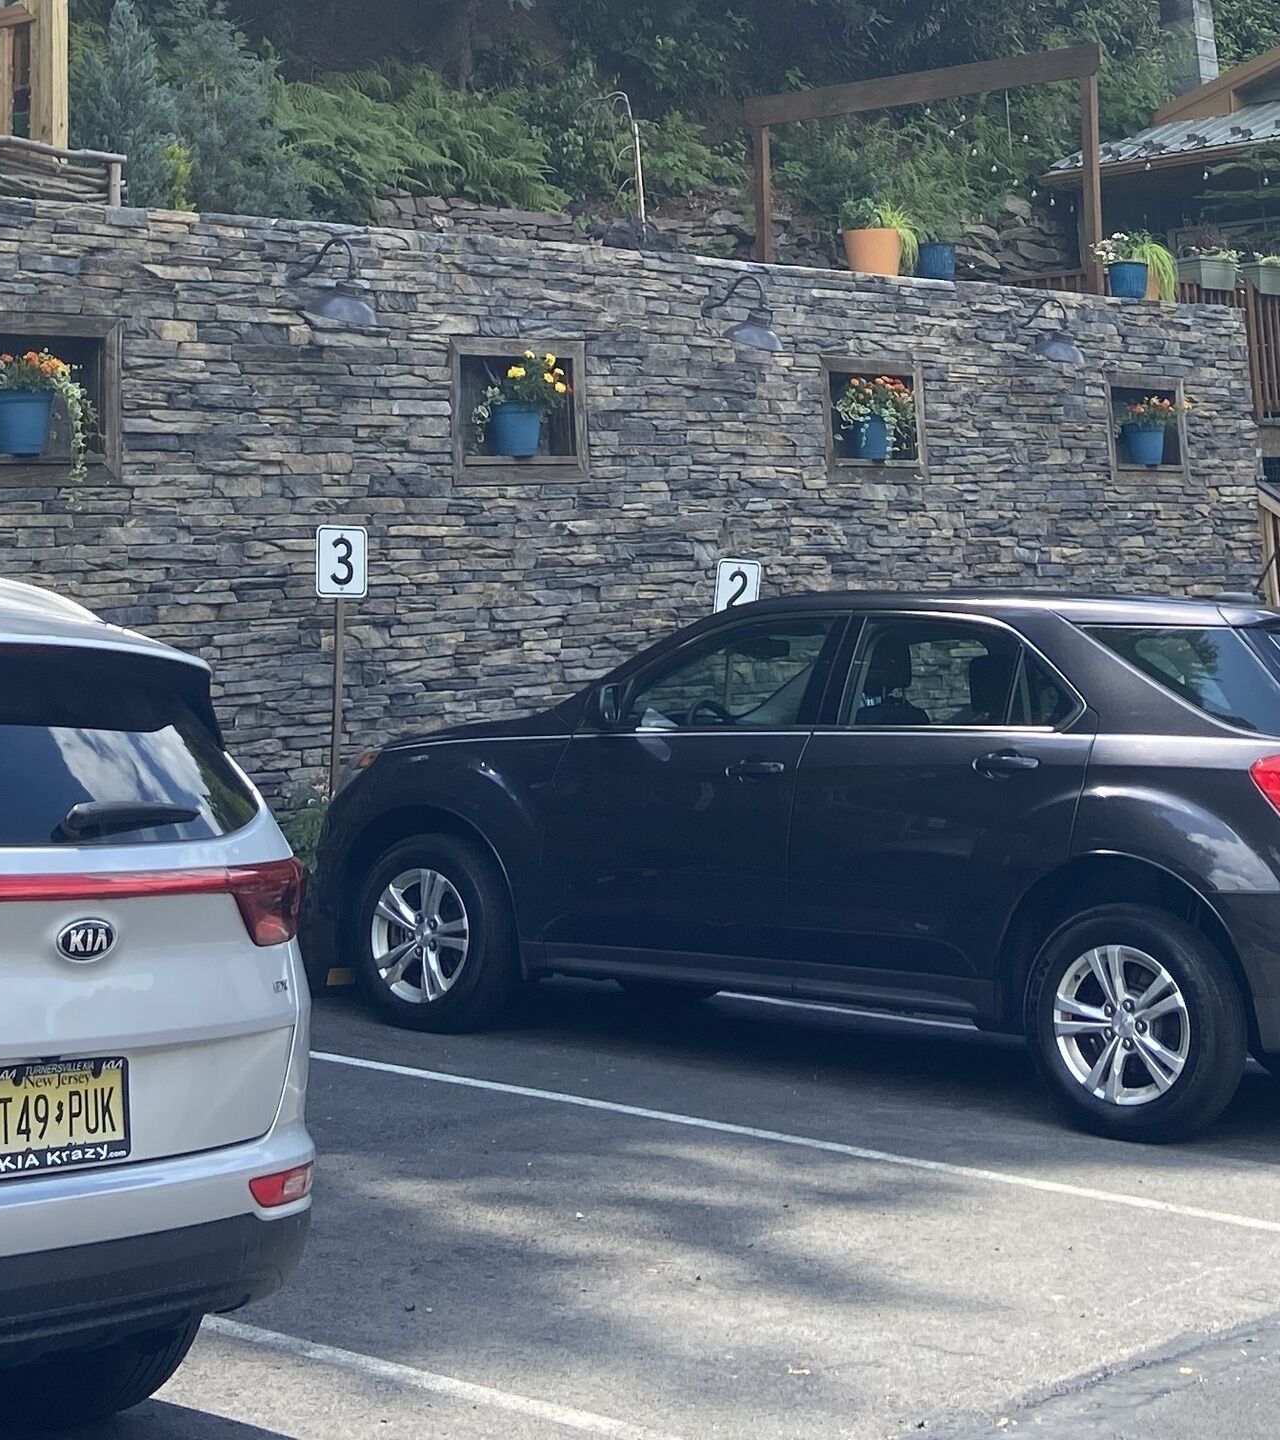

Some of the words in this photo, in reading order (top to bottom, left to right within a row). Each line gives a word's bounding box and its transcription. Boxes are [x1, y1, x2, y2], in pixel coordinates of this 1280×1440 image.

[330, 537, 354, 586] 3
[726, 570, 748, 608] 2
[69, 928, 108, 952] KIA
[25, 1062, 82, 1076] TURNERSVILLE
[82, 1061, 95, 1071] KIA
[23, 1076, 53, 1089] New
[55, 1073, 91, 1089] Jersey
